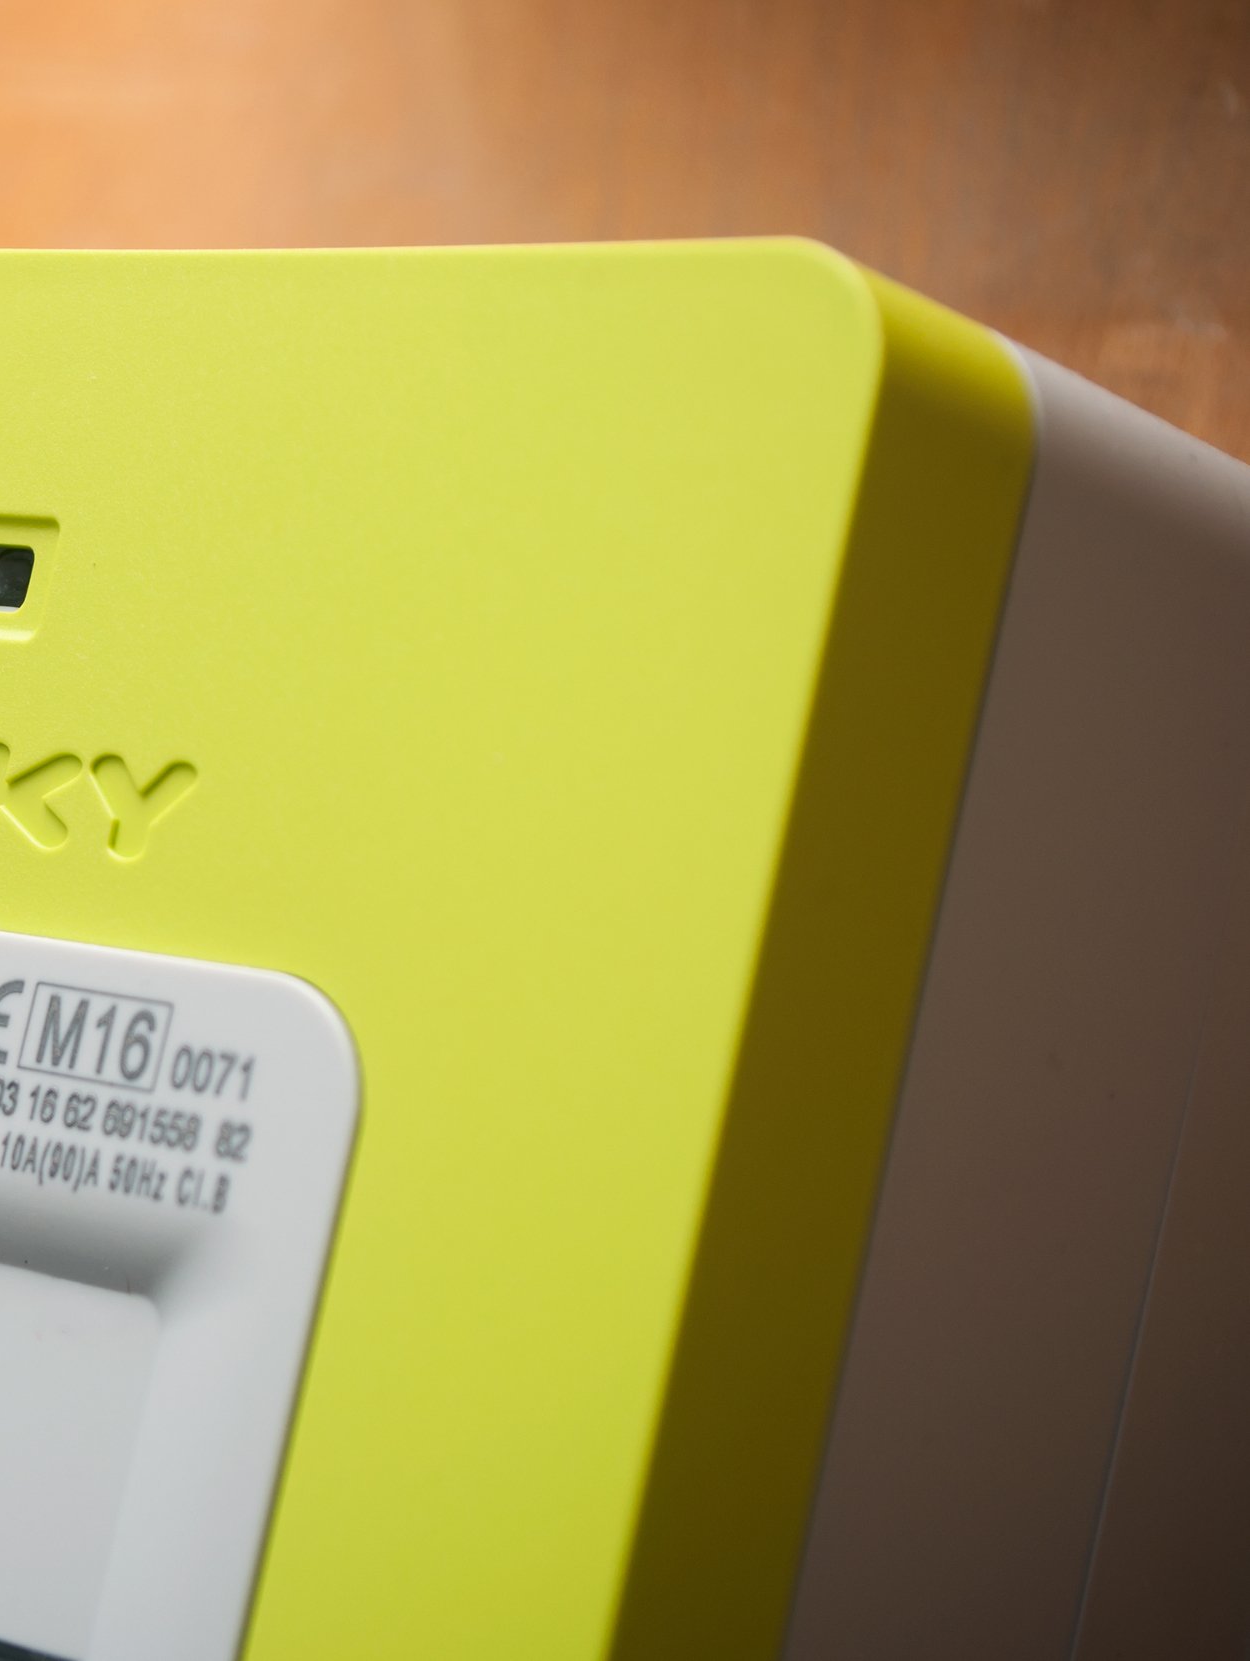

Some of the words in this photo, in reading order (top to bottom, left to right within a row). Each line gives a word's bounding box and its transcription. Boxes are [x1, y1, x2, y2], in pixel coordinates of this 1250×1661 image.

[35, 993, 157, 1081] M16
[170, 1044, 256, 1102] 0071
[28, 1086, 58, 1124] 16
[62, 1093, 97, 1131] 62
[102, 1100, 203, 1151] 691558
[213, 1118, 252, 1163] 82
[1, 1131, 100, 1192] 10A(90)A
[107, 1154, 167, 1202] 50Hz
